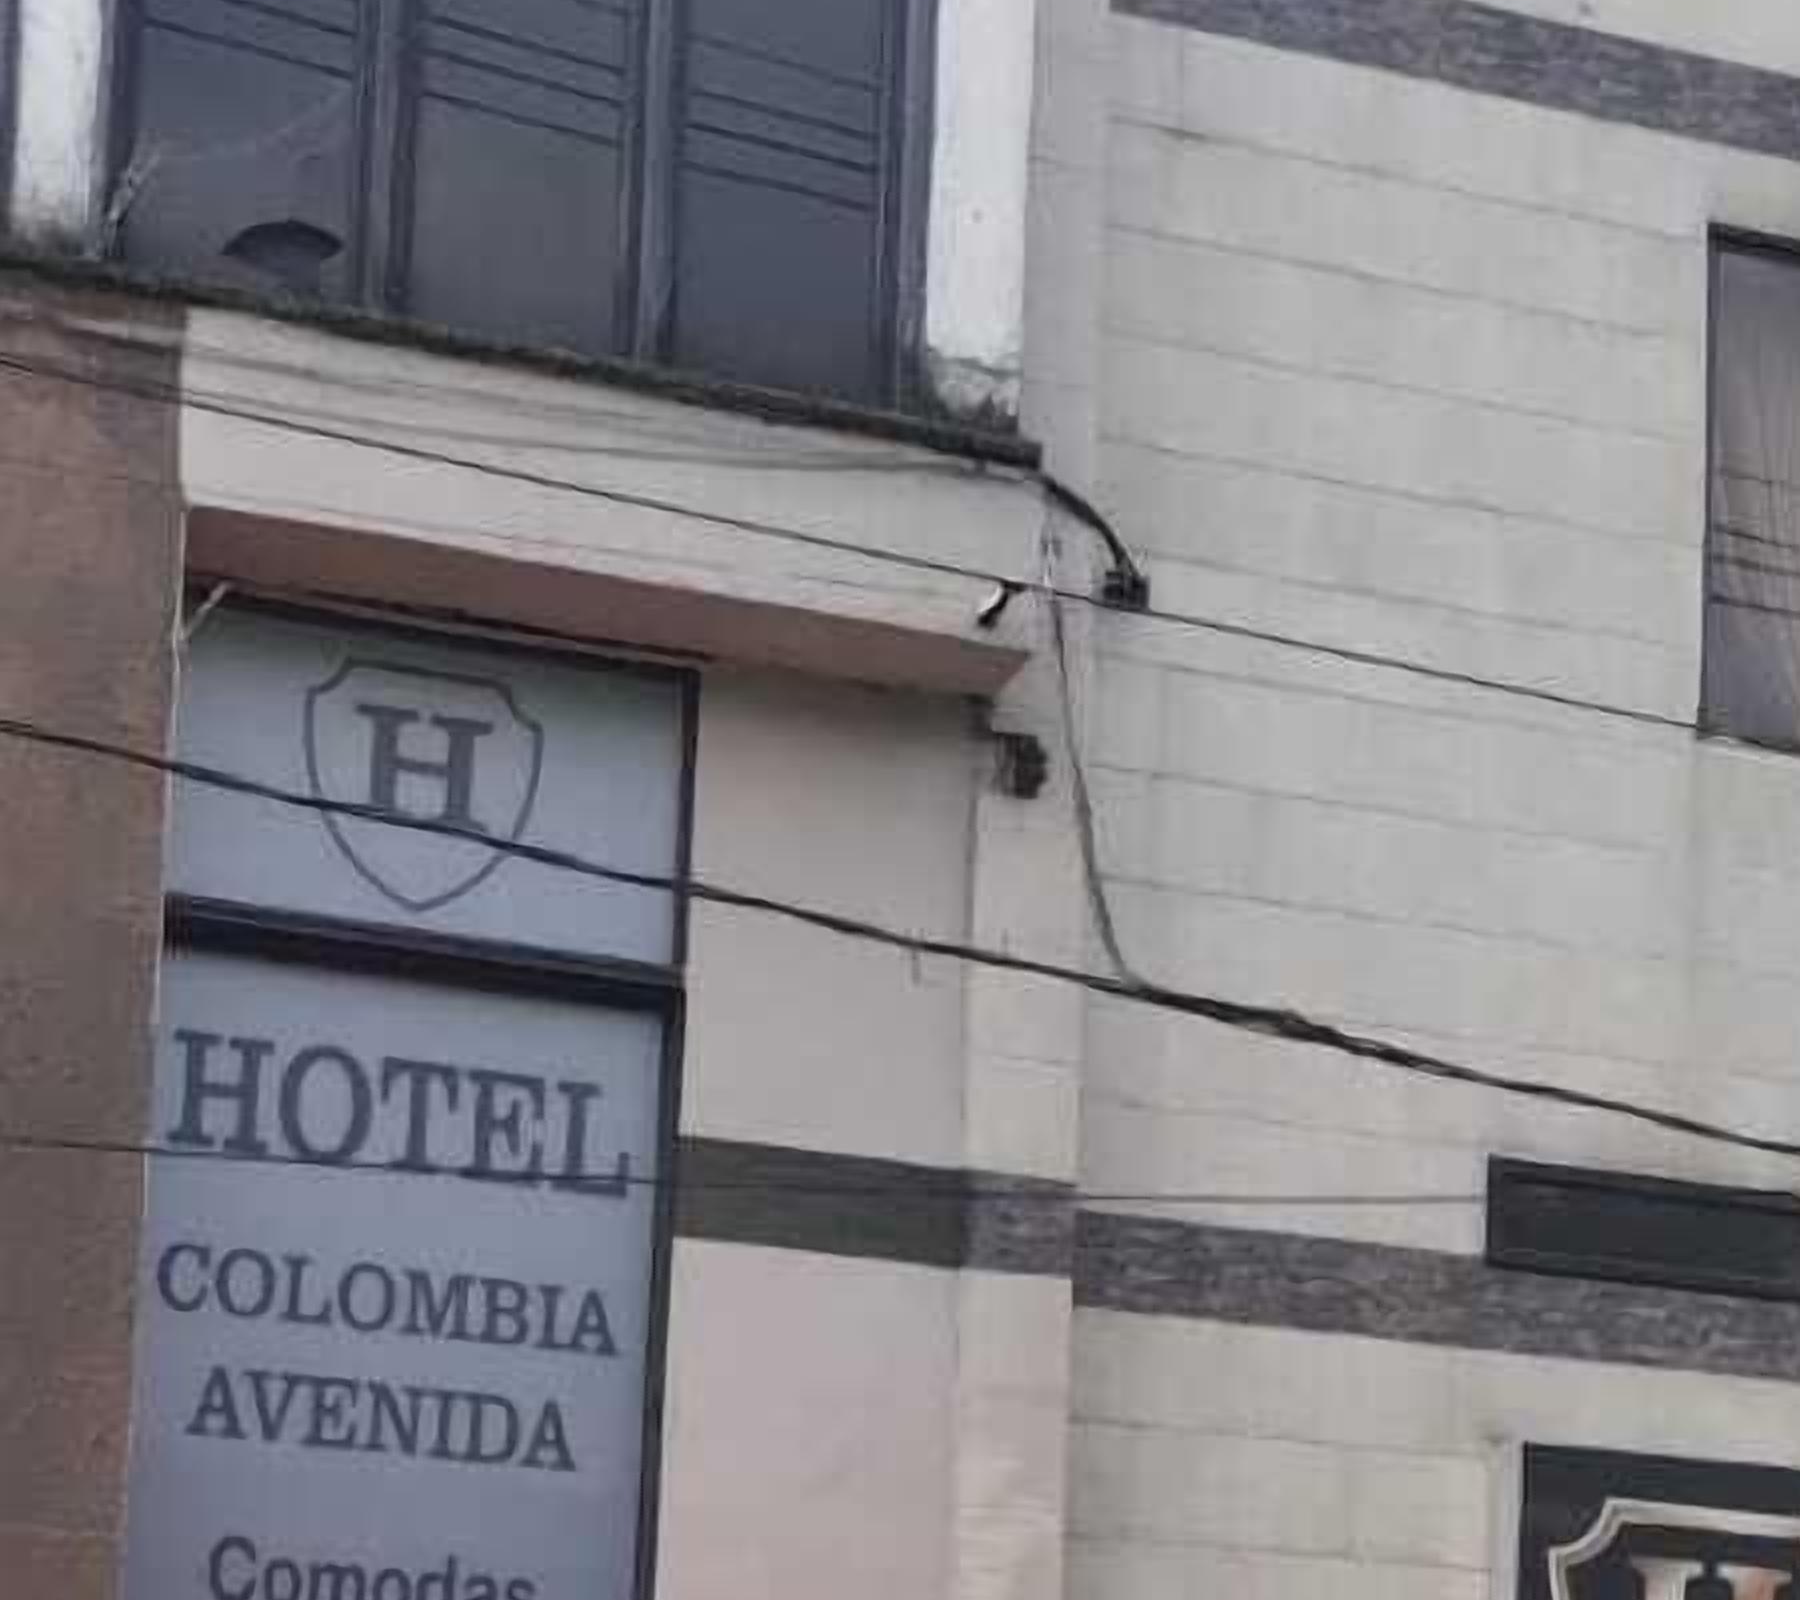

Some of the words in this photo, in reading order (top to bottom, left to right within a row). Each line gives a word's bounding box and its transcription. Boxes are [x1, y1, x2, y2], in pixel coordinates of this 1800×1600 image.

[355, 703, 494, 835] H
[164, 1029, 630, 1198] HOTEL
[156, 1242, 618, 1357] COLOMBIA
[186, 1367, 576, 1472] AVENIDA
